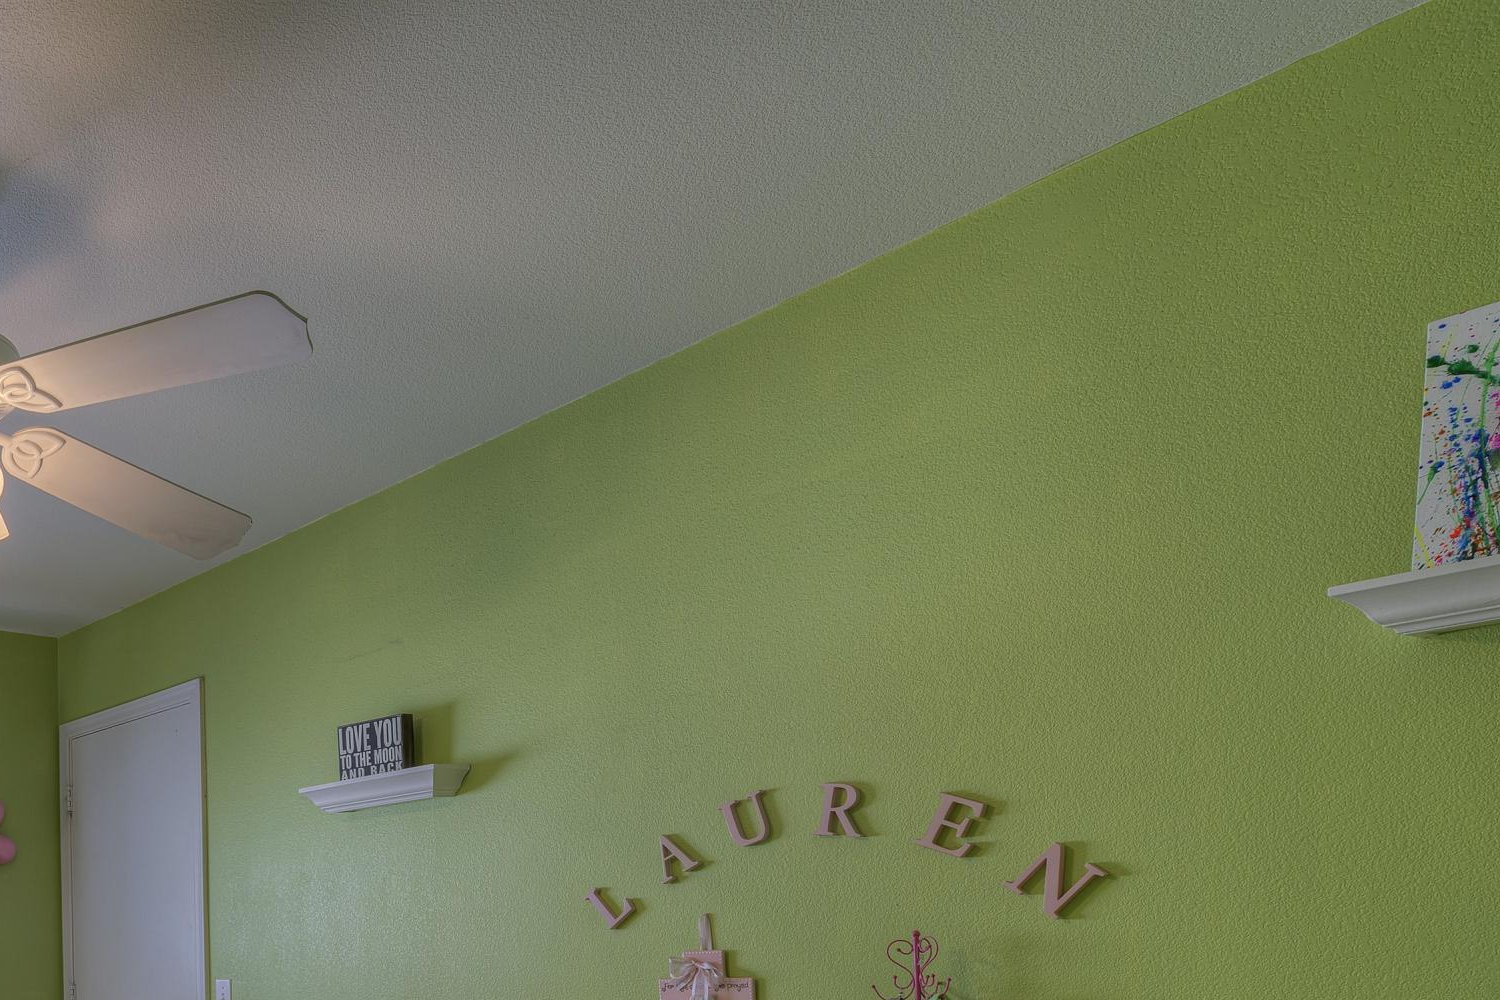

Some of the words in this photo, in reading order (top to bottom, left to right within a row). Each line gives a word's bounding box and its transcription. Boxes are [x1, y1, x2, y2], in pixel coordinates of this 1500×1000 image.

[339, 722, 371, 755] LOVE
[374, 716, 402, 748] YOU
[340, 754, 352, 770] TO
[354, 750, 372, 768] THE
[374, 745, 403, 764] MOON
[341, 767, 365, 781] AND
[370, 760, 404, 776] BACK
[585, 781, 1109, 930] LAUREN
